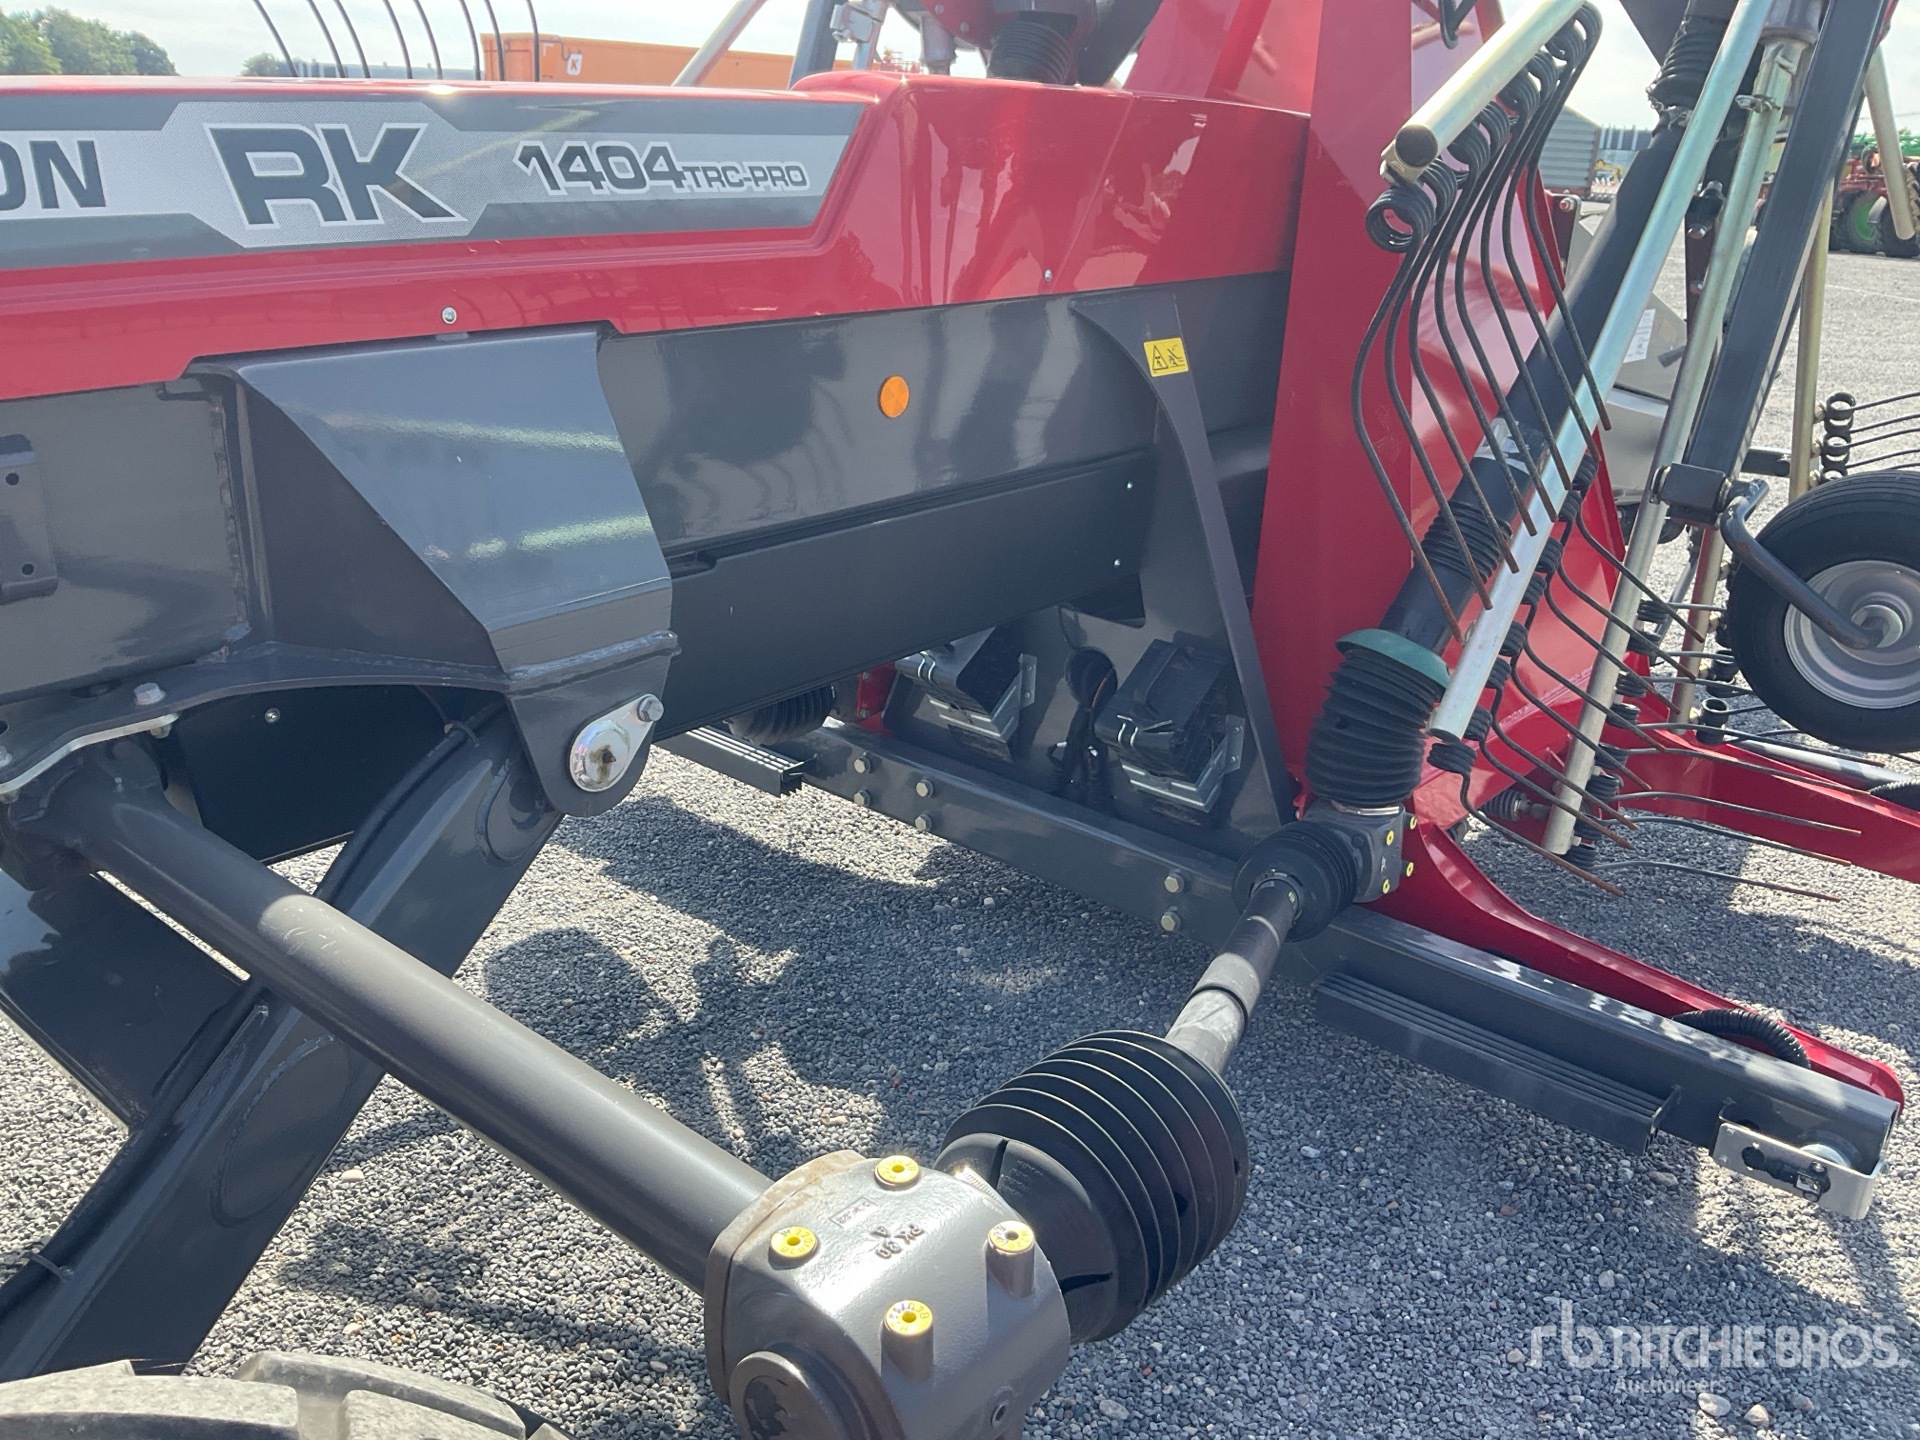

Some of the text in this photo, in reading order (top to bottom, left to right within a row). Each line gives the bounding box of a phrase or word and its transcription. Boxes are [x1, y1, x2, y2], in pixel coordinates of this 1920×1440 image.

[205, 124, 466, 229] RK
[516, 143, 686, 192] 1404
[682, 164, 809, 190] TRC-PRO
